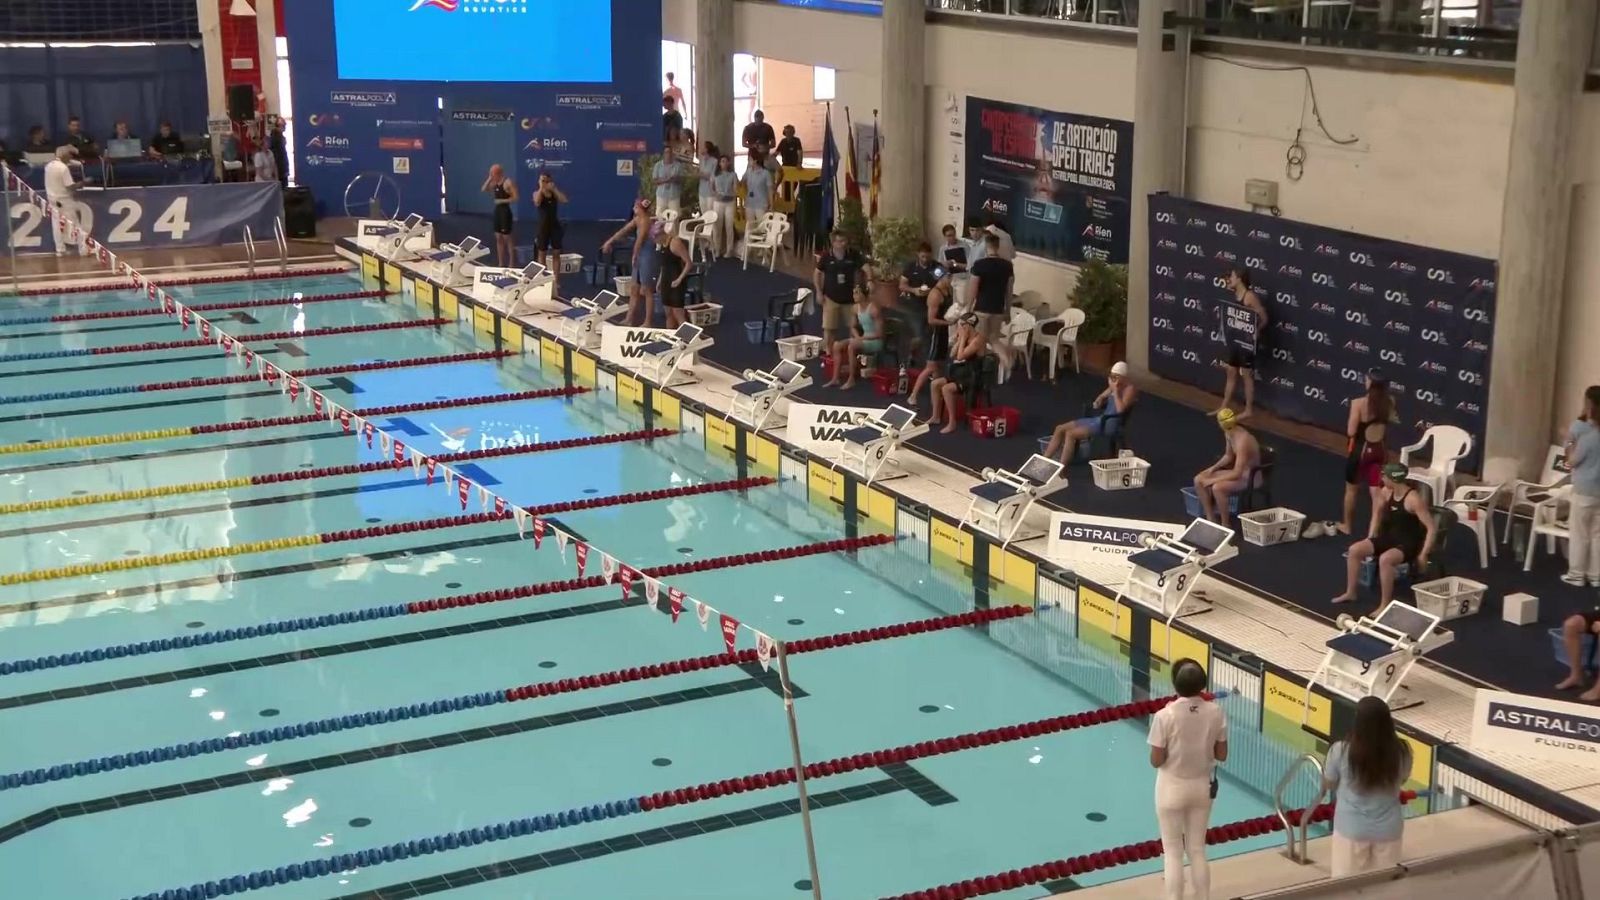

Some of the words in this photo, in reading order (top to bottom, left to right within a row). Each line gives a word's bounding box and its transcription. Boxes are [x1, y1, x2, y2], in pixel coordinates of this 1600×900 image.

[1053, 121, 1065, 145] DE
[1067, 123, 1118, 154] NATACIÓN
[1052, 145, 1077, 172] OPEN
[1079, 150, 1115, 178] TRIALS
[394, 237, 402, 247] 0
[565, 264, 571, 273] 0
[514, 290, 520, 301] 2
[704, 315, 711, 325] 2
[1227, 306, 1251, 322] BILLETE
[585, 321, 592, 332] 3
[807, 347, 813, 358] 3
[666, 356, 676, 368] 4
[763, 396, 771, 410] 5
[810, 428, 846, 442] WA
[996, 422, 1005, 436] 5
[876, 446, 885, 460] 6
[1122, 473, 1131, 487] 6
[1011, 503, 1020, 520] 7
[1063, 529, 1138, 545] ASTRALPO
[1279, 528, 1287, 541] 7
[1092, 546, 1136, 557] FLUIDRA
[1177, 573, 1186, 591] 8
[1460, 600, 1470, 615] 8
[1361, 660, 1370, 676] 9
[1386, 664, 1396, 683] 9
[1535, 737, 1597, 754] FLUIDRA
